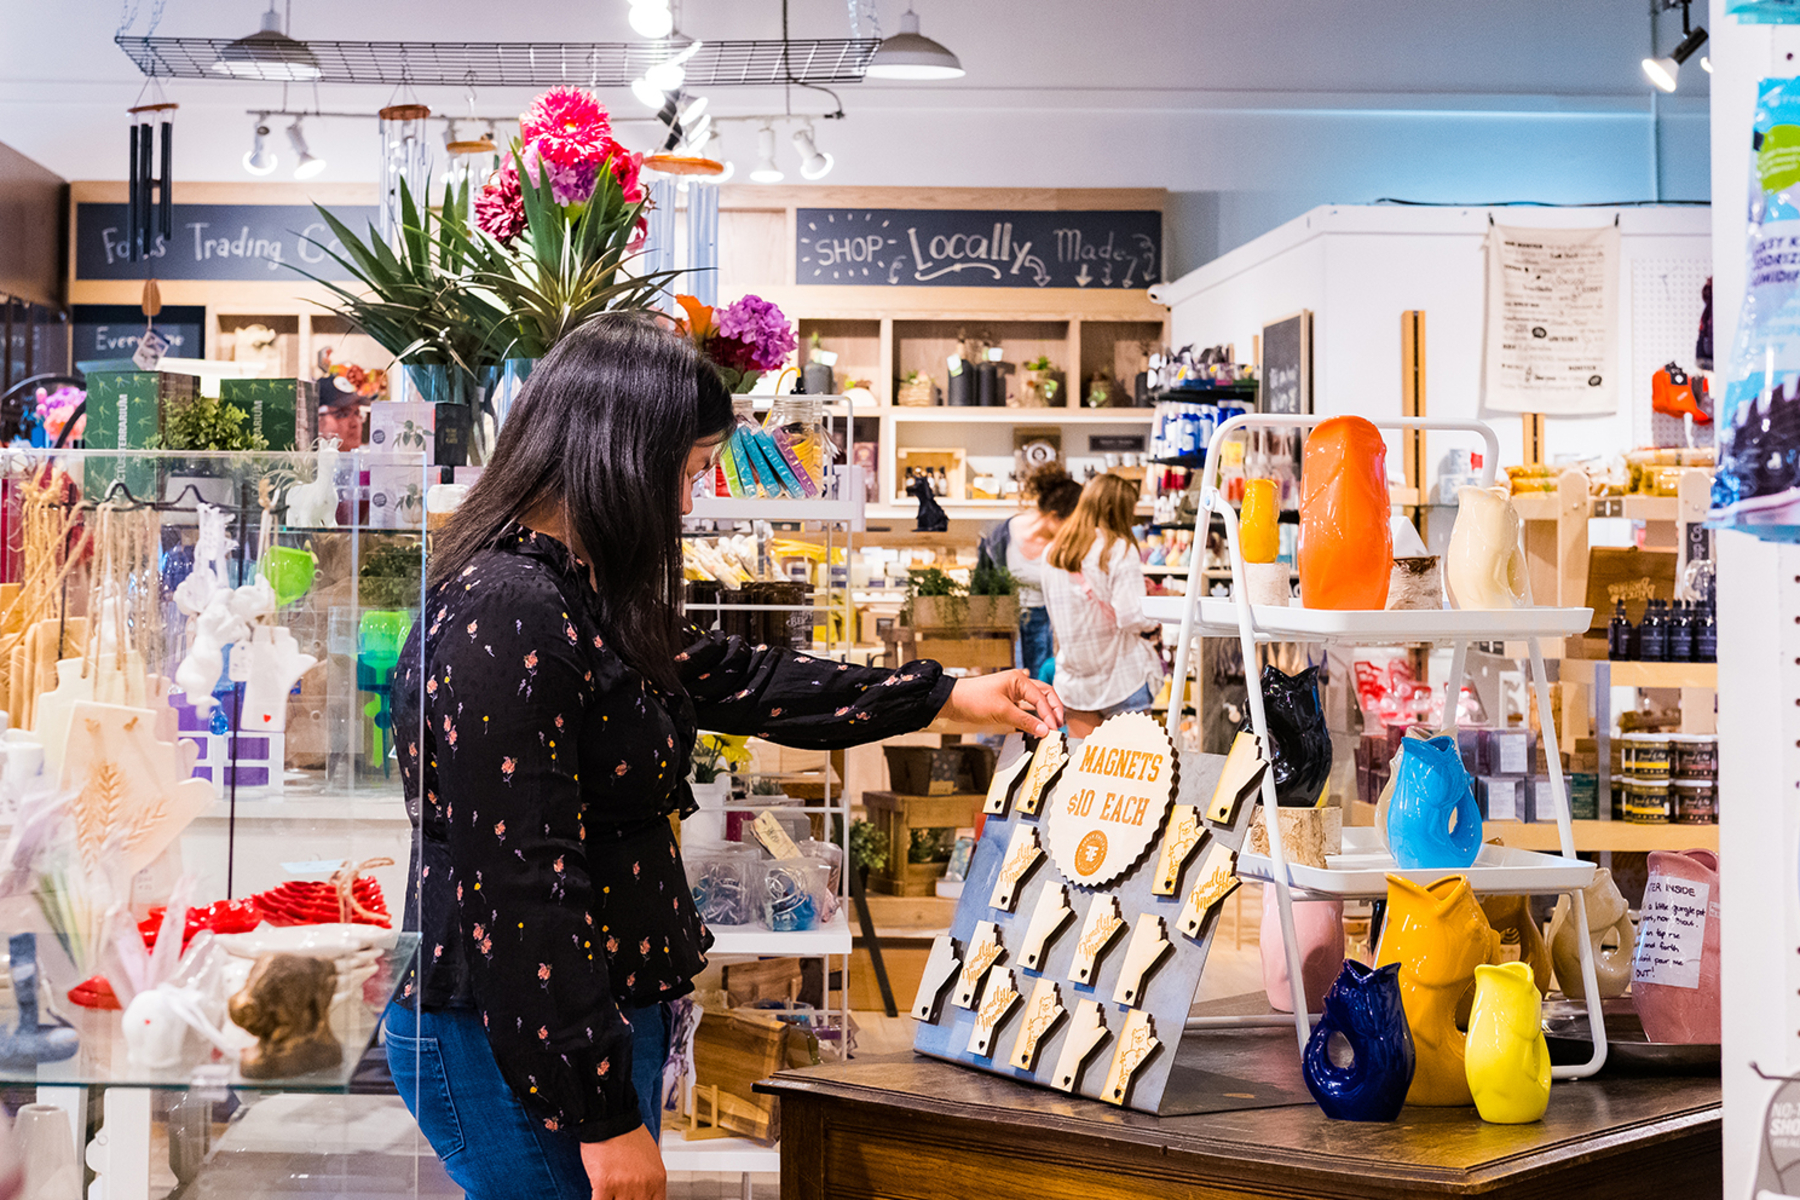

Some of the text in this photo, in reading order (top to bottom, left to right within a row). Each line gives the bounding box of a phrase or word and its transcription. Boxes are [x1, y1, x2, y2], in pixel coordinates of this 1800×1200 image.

[102, 227, 167, 264] Fos
[185, 222, 285, 271] Trading
[815, 221, 1126, 275] SHOP Locally Made
[117, 393, 128, 450] TERRARIUM
[1078, 744, 1164, 782] MAGNETS
[1066, 788, 1151, 826] $10 EACH
[1666, 884, 1696, 897] INSIDE
